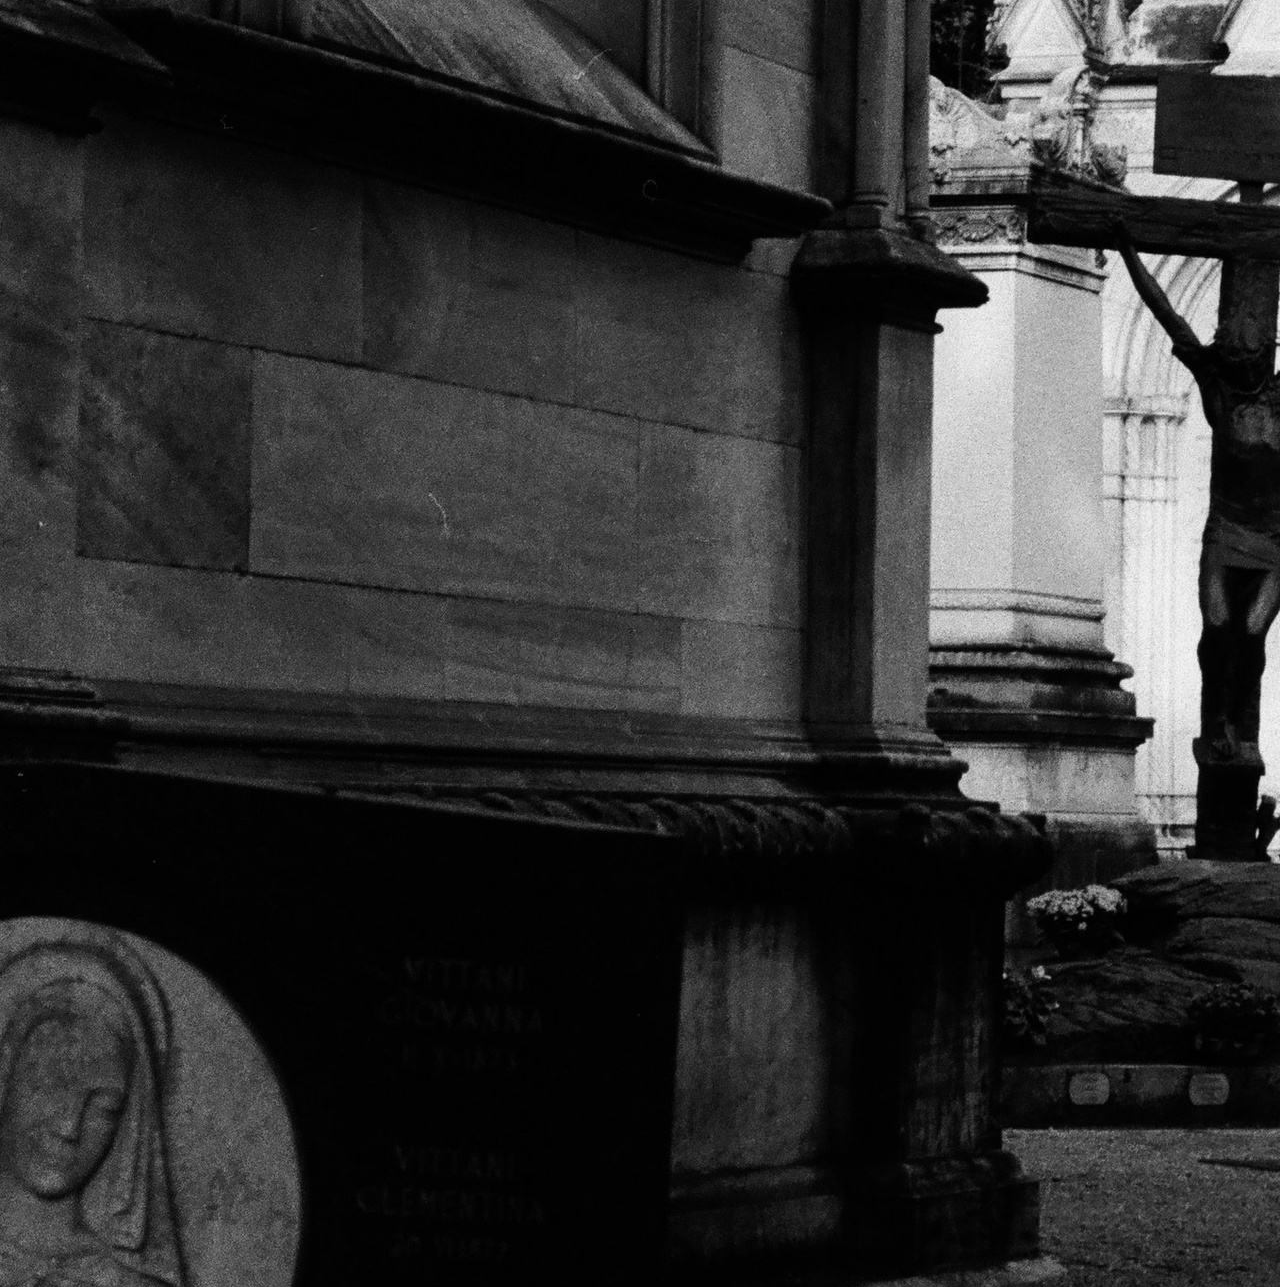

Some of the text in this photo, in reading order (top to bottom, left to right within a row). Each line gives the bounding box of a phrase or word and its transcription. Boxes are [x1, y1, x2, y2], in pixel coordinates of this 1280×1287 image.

[403, 955, 525, 994] VITTANI
[379, 996, 543, 1035] GIOVANNA
[394, 1144, 515, 1180] VITTANI
[356, 1184, 547, 1225] CLEMENTINA
